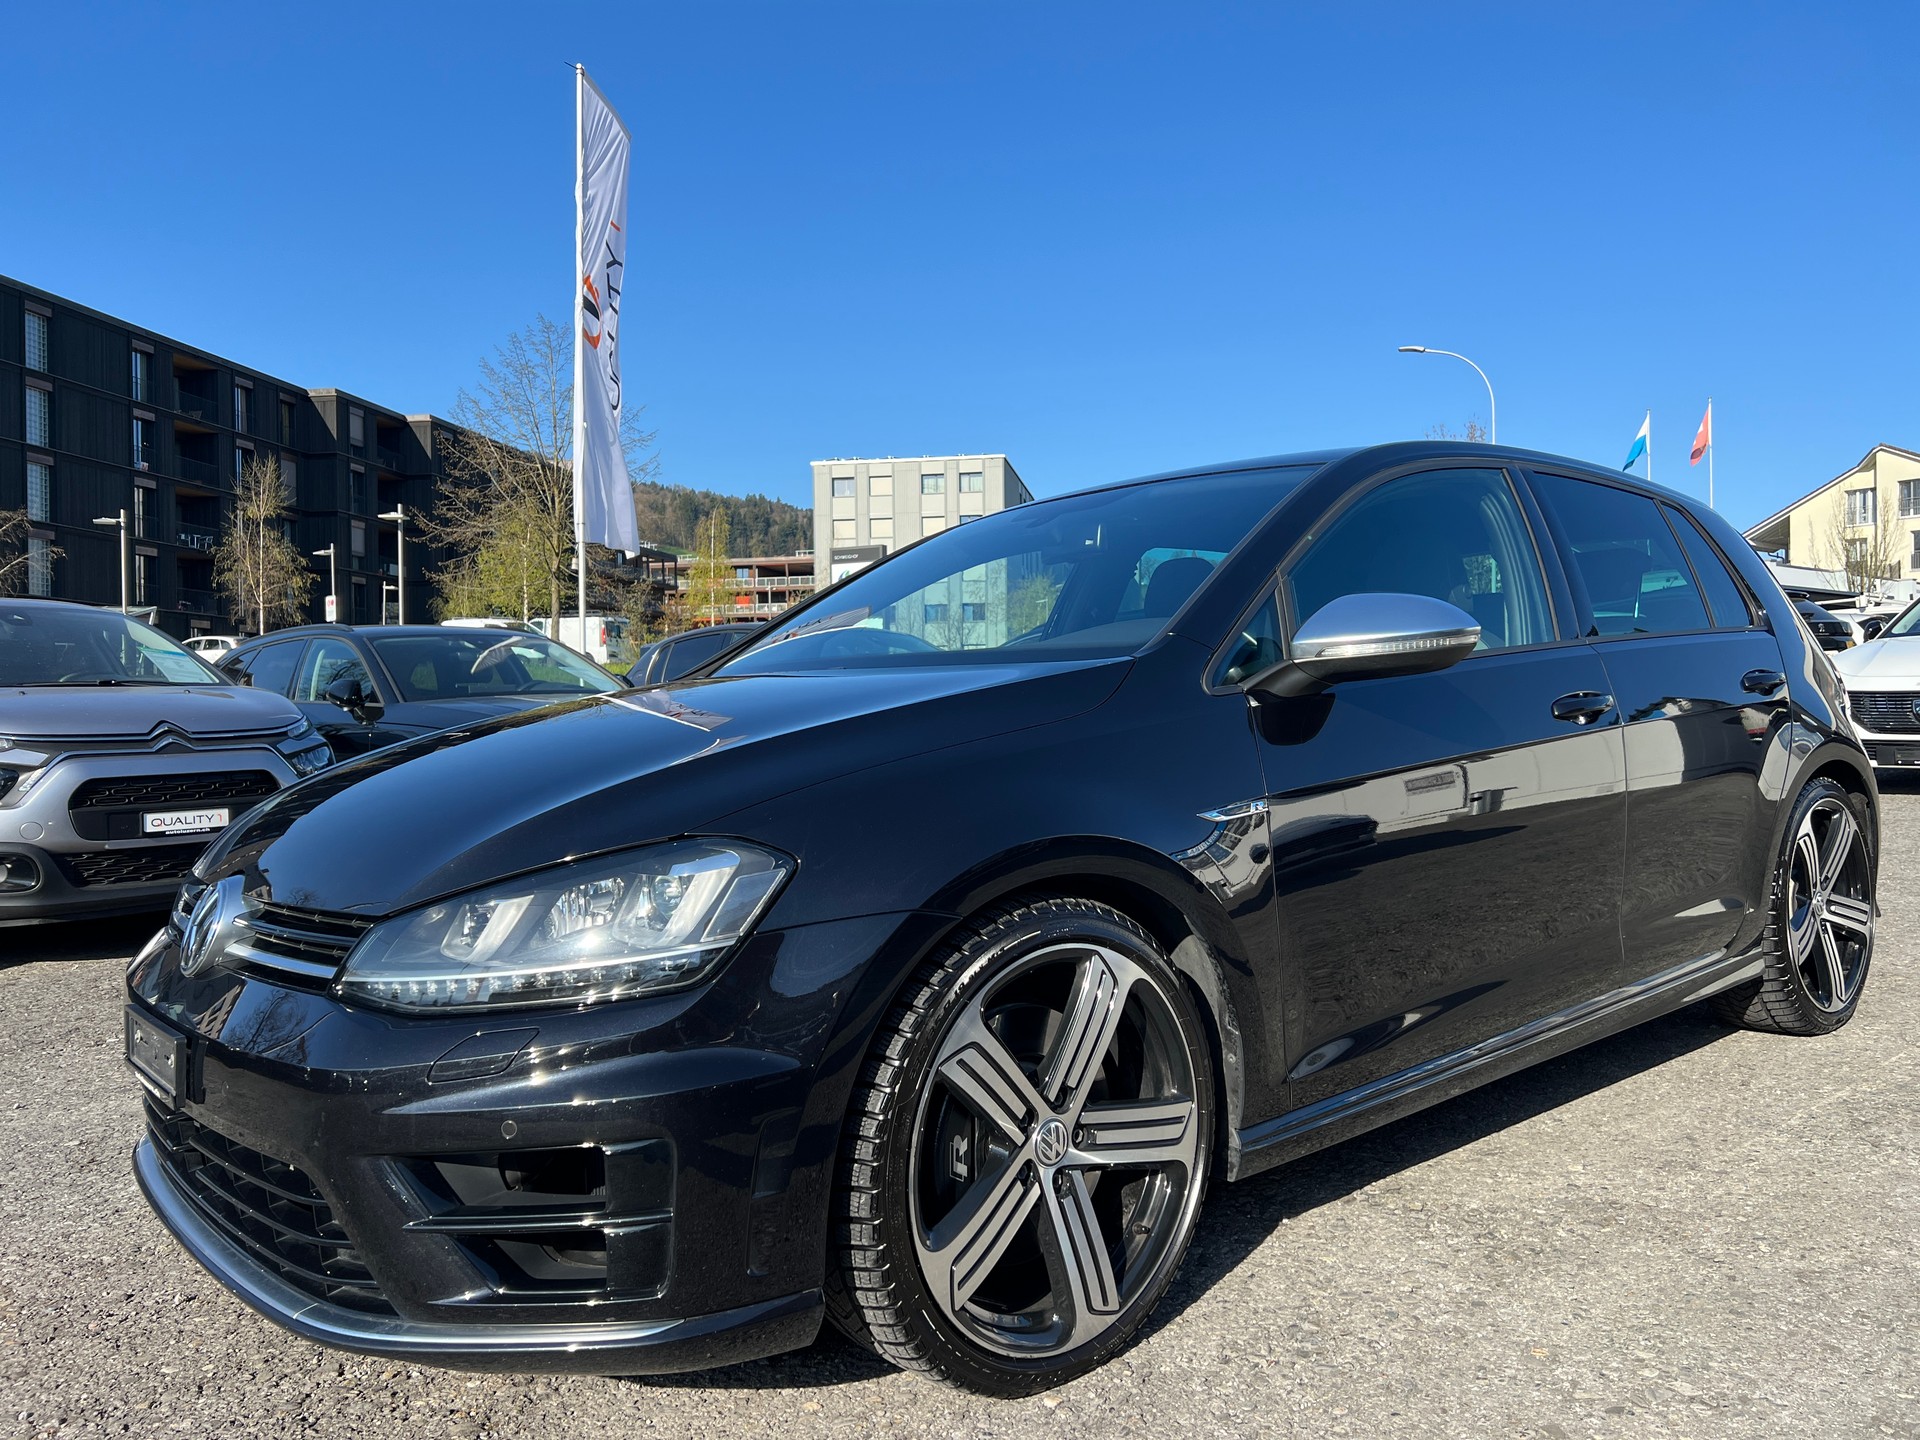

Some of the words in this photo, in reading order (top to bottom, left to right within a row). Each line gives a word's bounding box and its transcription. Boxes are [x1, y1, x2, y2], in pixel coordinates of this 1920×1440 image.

[151, 814, 214, 828] QUALITY
[217, 813, 223, 823] 1
[165, 827, 211, 835] autoluzern.ch
